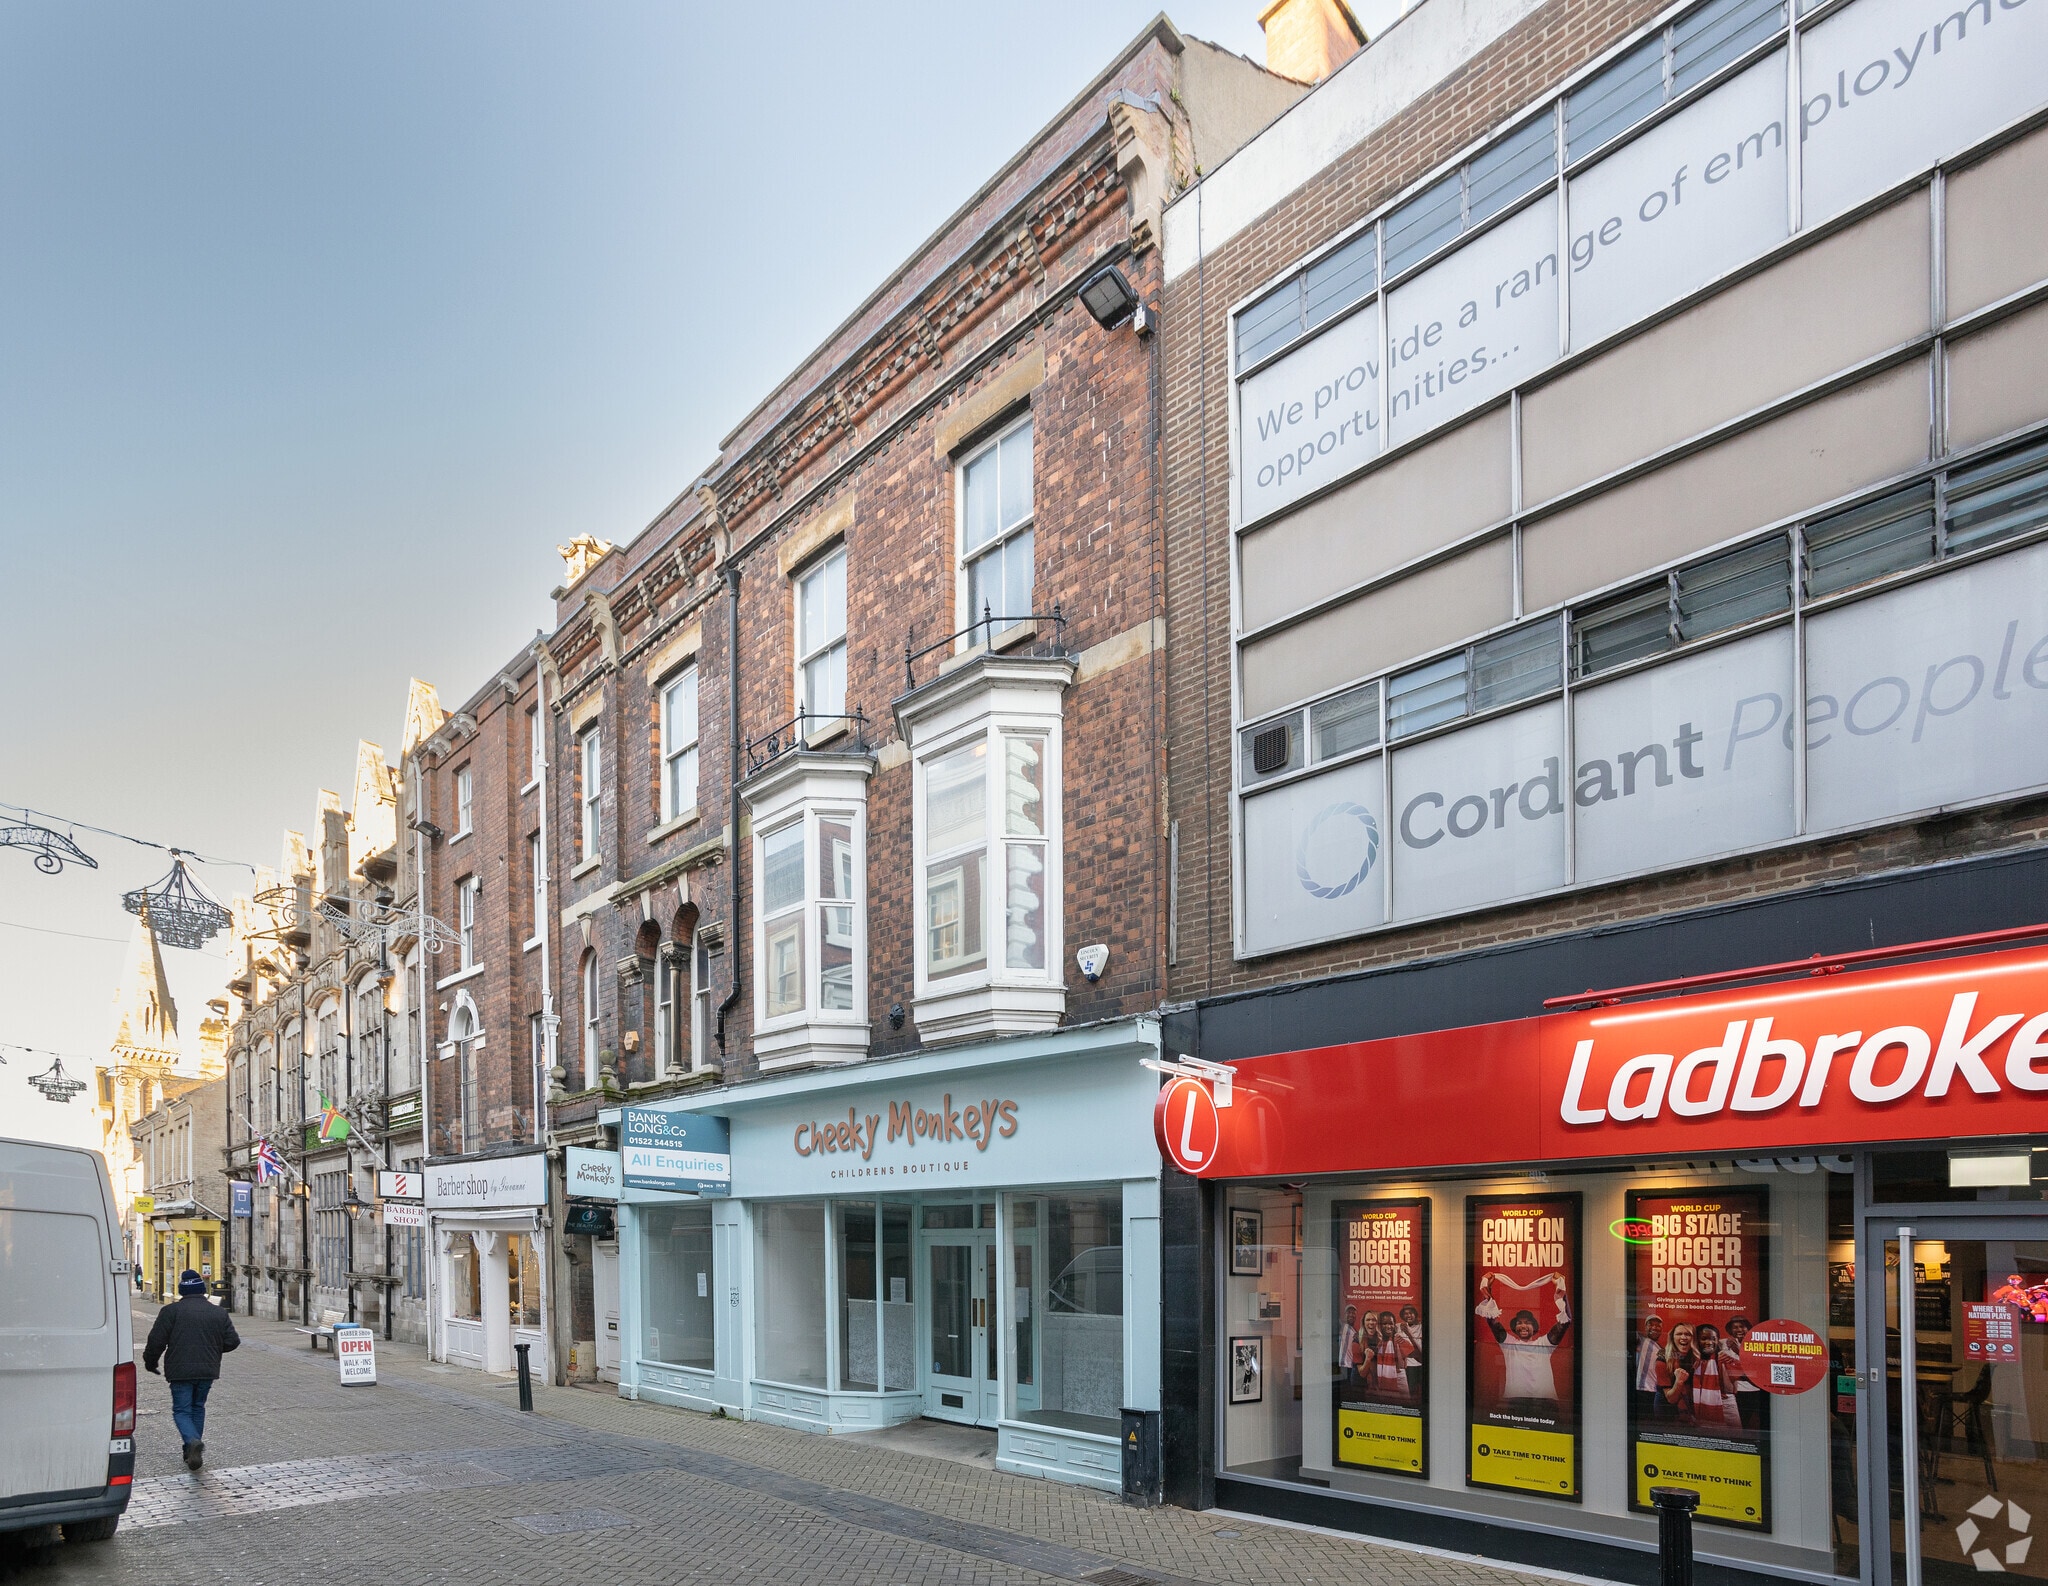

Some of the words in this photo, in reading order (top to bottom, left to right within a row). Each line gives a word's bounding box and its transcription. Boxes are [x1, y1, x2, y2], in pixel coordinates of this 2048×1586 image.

[1257, 401, 1304, 442] We
[1314, 321, 1443, 419] provide
[1458, 300, 1478, 330] a
[1495, 216, 1623, 309] range
[1638, 165, 1688, 223] of
[1703, 0, 2028, 185] employm
[1399, 722, 1704, 850] Cordant
[628, 1111, 667, 1125] BANKS
[794, 1106, 881, 1161] Cheeky
[888, 1093, 1018, 1151] Monkeys
[1180, 1090, 1203, 1162] L
[628, 1122, 687, 1137] LONG&Co
[629, 1137, 652, 1146] 01522
[654, 1138, 683, 1148] 544515
[580, 1163, 612, 1176] Cheeky
[631, 1153, 651, 1166] All
[656, 1155, 724, 1172] Enquiries
[831, 1166, 895, 1179] CHILDRENS
[903, 1161, 969, 1175] BOUTIQUE
[438, 1176, 465, 1196] Barber
[466, 1174, 488, 1200] shop
[576, 1170, 615, 1186] Monkeys
[386, 1205, 424, 1216] BARBER
[394, 1216, 420, 1225] SHOP
[1350, 1221, 1370, 1238] BIG
[1372, 1220, 1410, 1238] STAGE
[1652, 1214, 1682, 1236] BIG
[1686, 1214, 1742, 1236] STAGE
[1482, 1218, 1534, 1242] COME
[1538, 1218, 1564, 1242] ON
[1350, 1240, 1410, 1264] BIGGER
[1482, 1244, 1564, 1268] ENGLAND
[1652, 1237, 1742, 1266] BIGGER
[1350, 1264, 1410, 1288] BOOSTS
[1652, 1268, 1742, 1295] BOOSTS
[341, 1341, 372, 1352] OPEN
[1751, 1332, 1768, 1341] JOIN
[1770, 1332, 1787, 1342] OUR
[1788, 1333, 1814, 1343] TEAM!
[1744, 1342, 1764, 1352] EARN
[1766, 1343, 1780, 1353] £10
[1782, 1344, 1798, 1354] PER
[1799, 1345, 1822, 1355] HOUR
[344, 1367, 372, 1375] WELCOME
[1542, 1455, 1566, 1463] THINK
[1661, 1469, 1684, 1478] TAKE
[1686, 1472, 1707, 1481] TIME
[1723, 1478, 1752, 1487] THINK
